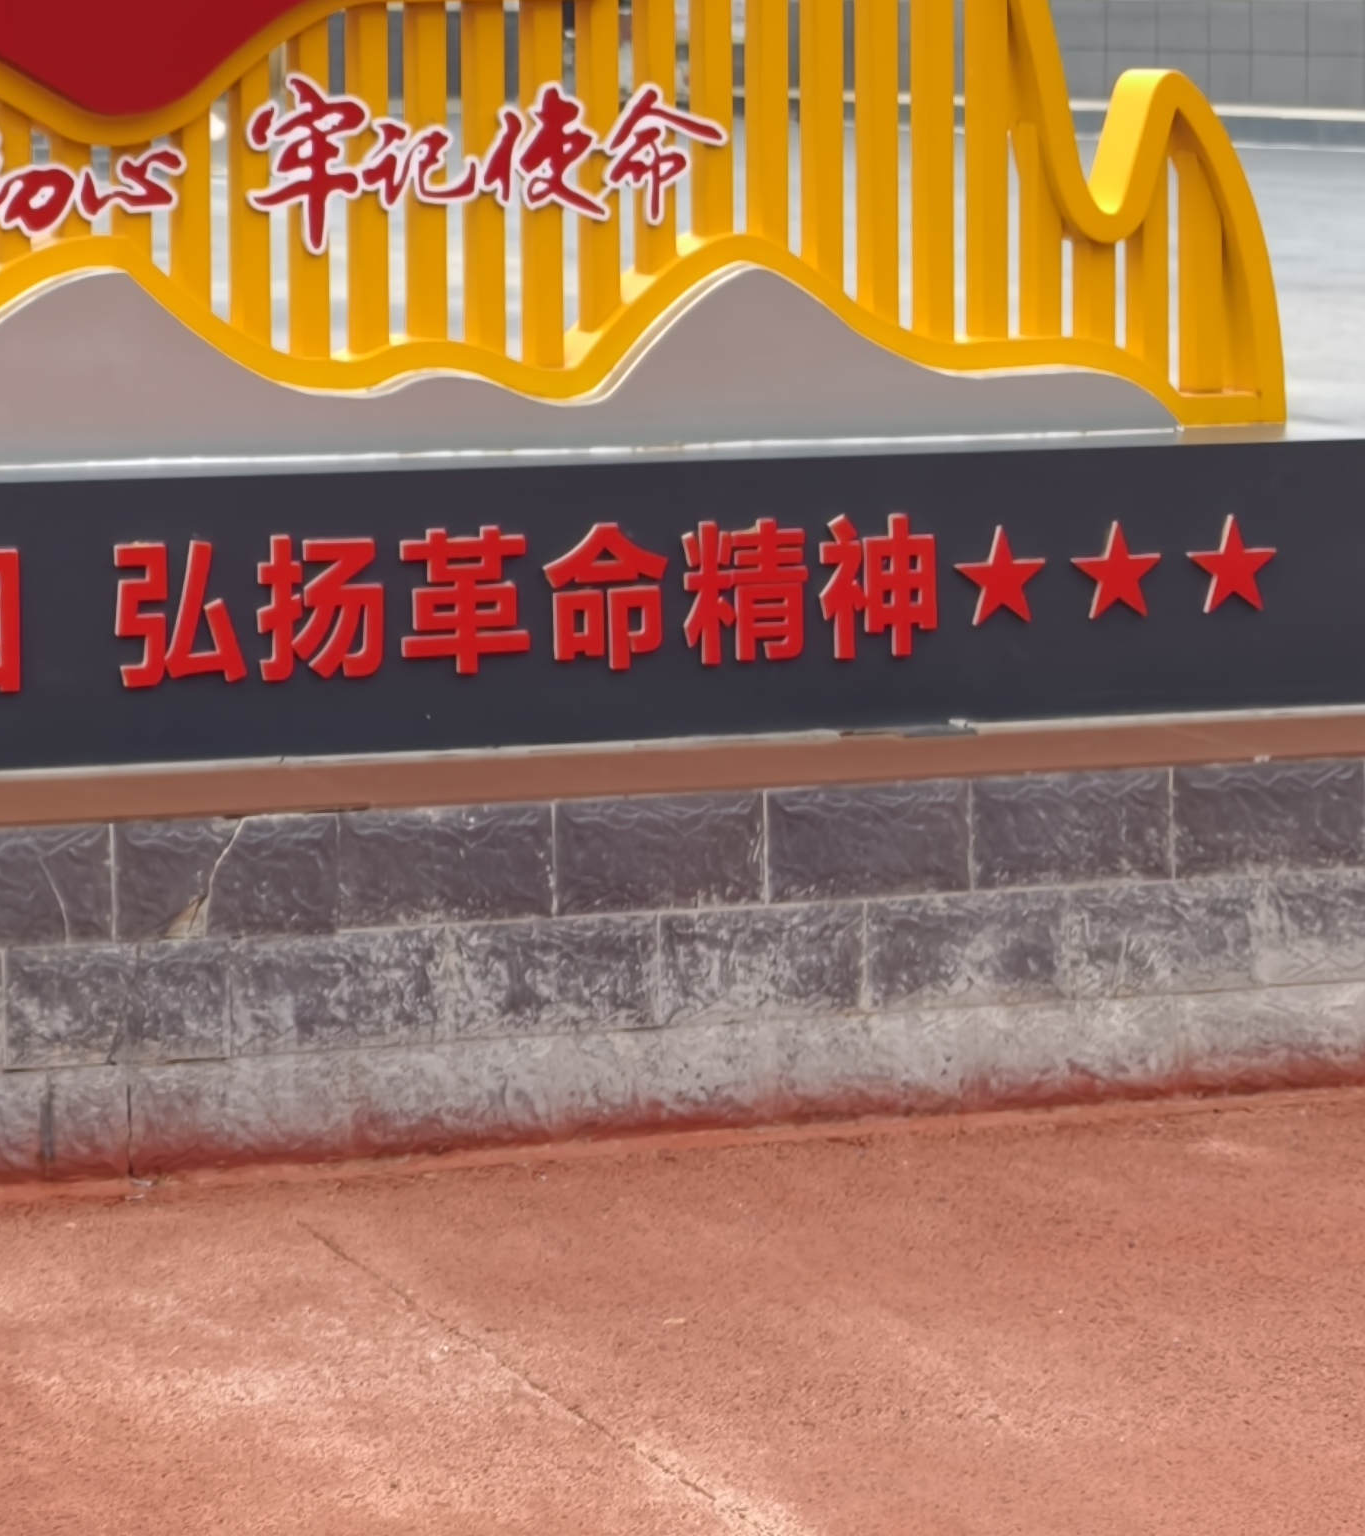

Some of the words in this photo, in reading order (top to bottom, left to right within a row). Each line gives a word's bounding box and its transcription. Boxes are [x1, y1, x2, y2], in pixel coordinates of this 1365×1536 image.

[249, 76, 723, 249] 牢记使命
[114, 514, 939, 689] 弘扬革命精神
